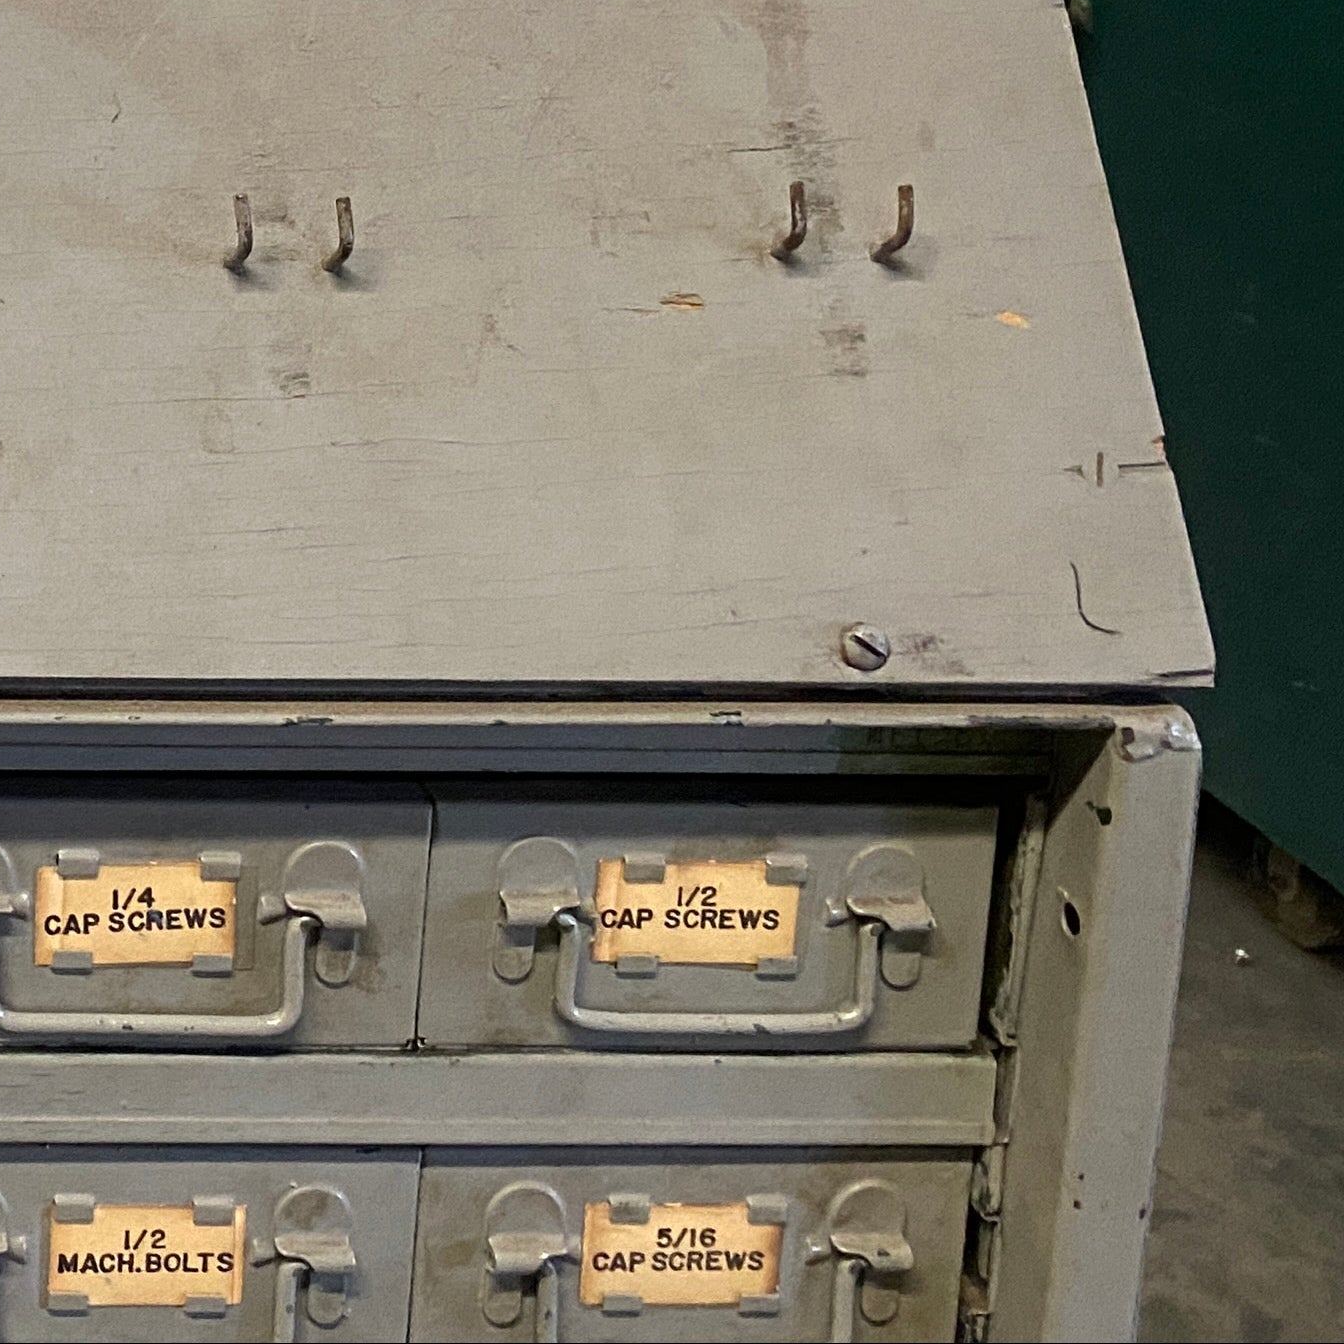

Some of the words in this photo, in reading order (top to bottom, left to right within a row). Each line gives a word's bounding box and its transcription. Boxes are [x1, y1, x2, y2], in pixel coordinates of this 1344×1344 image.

[112, 887, 155, 911] 1/4
[677, 886, 718, 907] 1/2
[44, 913, 100, 935] CAP
[108, 907, 226, 932] SCREWS
[600, 908, 654, 929] CAP
[664, 909, 780, 930] SCREWS
[123, 1229, 166, 1250] 1/2
[656, 1228, 717, 1249] 5/16
[592, 1252, 645, 1272] CAP
[651, 1250, 765, 1272] SCREWS
